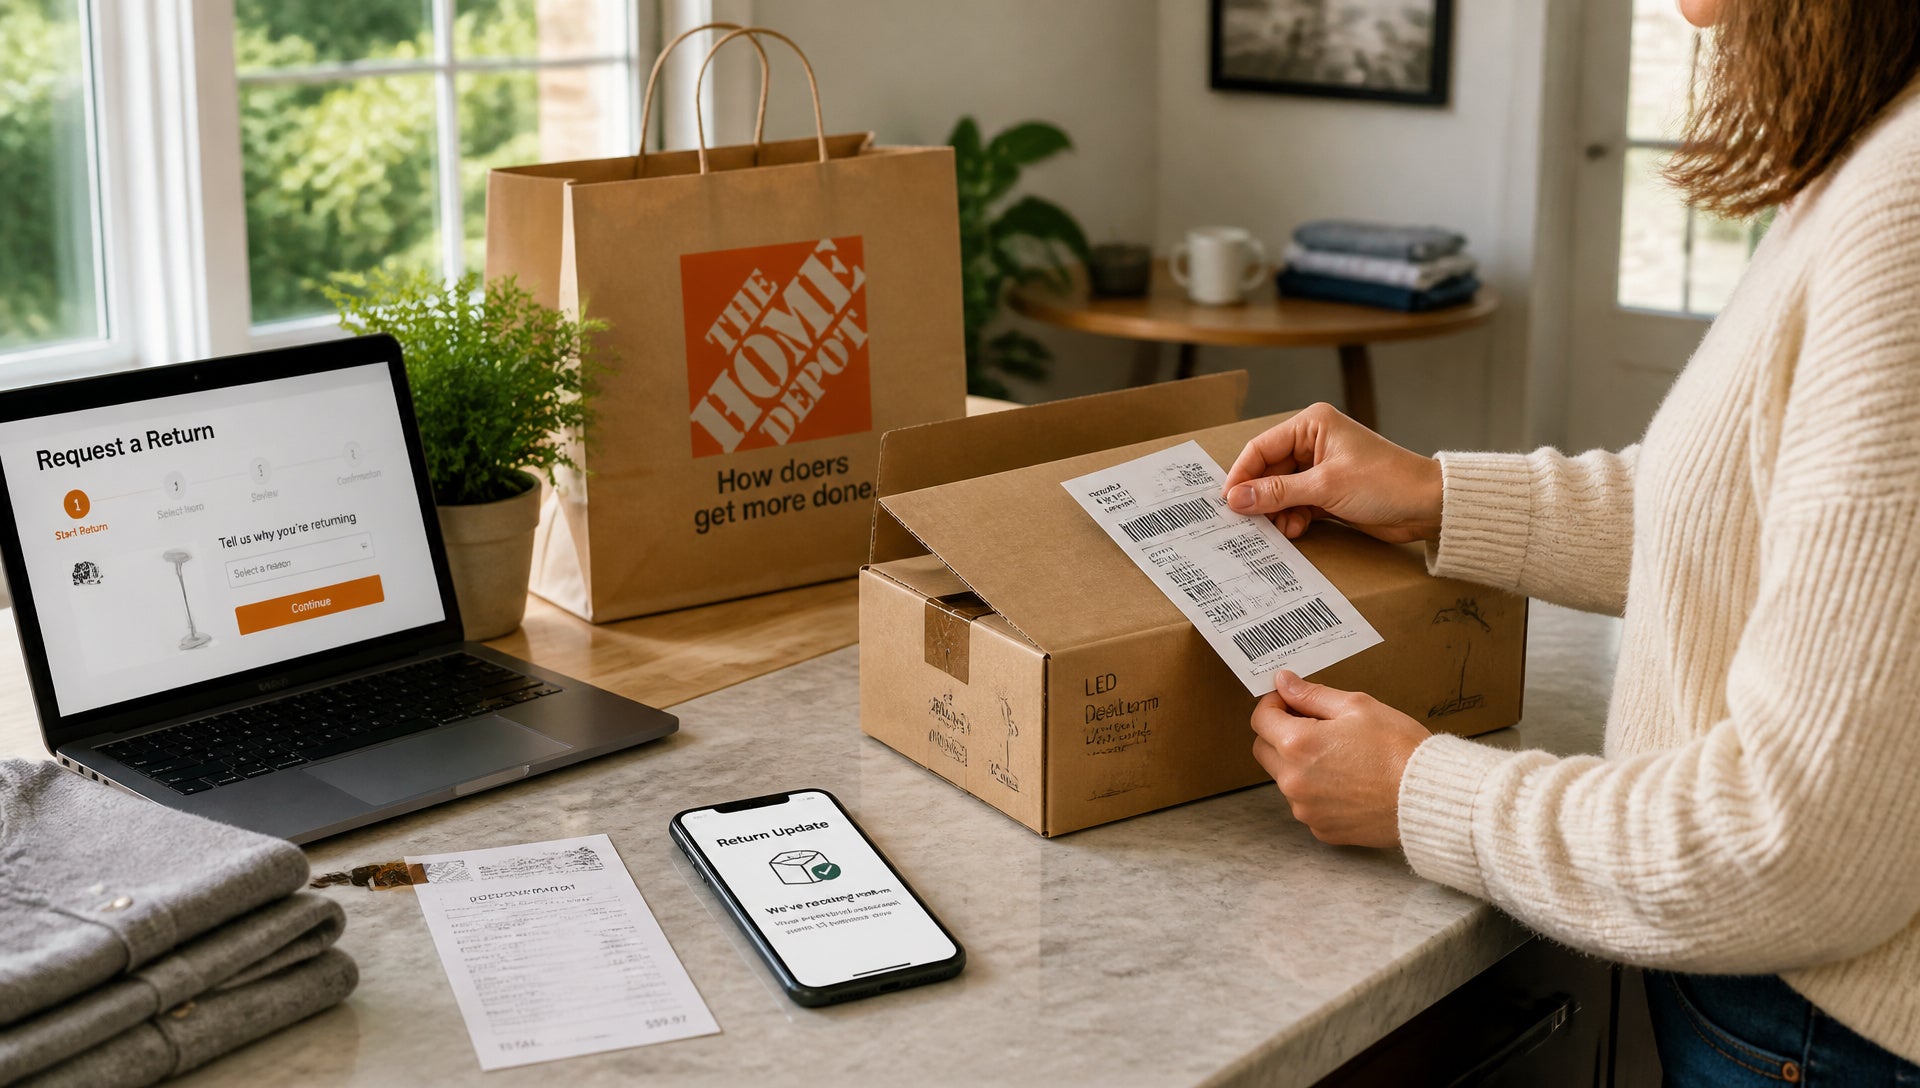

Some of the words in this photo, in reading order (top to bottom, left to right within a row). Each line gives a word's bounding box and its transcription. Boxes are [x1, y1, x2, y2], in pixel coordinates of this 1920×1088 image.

[704, 267, 779, 355] THE
[689, 238, 867, 454] HOME
[759, 308, 868, 446] DEPOT
[36, 436, 125, 471] Request
[130, 439, 142, 453] a
[146, 422, 215, 451] Return
[717, 468, 773, 494] How
[780, 455, 849, 483] doers
[694, 501, 736, 534] get
[743, 492, 806, 520] more
[813, 481, 878, 507] done.
[218, 535, 238, 549] Tell
[240, 534, 251, 545] us
[253, 529, 275, 543] why
[276, 523, 309, 541] you're
[311, 513, 357, 530] returning
[291, 597, 332, 614] Continue
[1085, 673, 1117, 697] LED
[716, 831, 771, 848] Return
[771, 820, 830, 837] Update
[765, 903, 804, 915] We've
